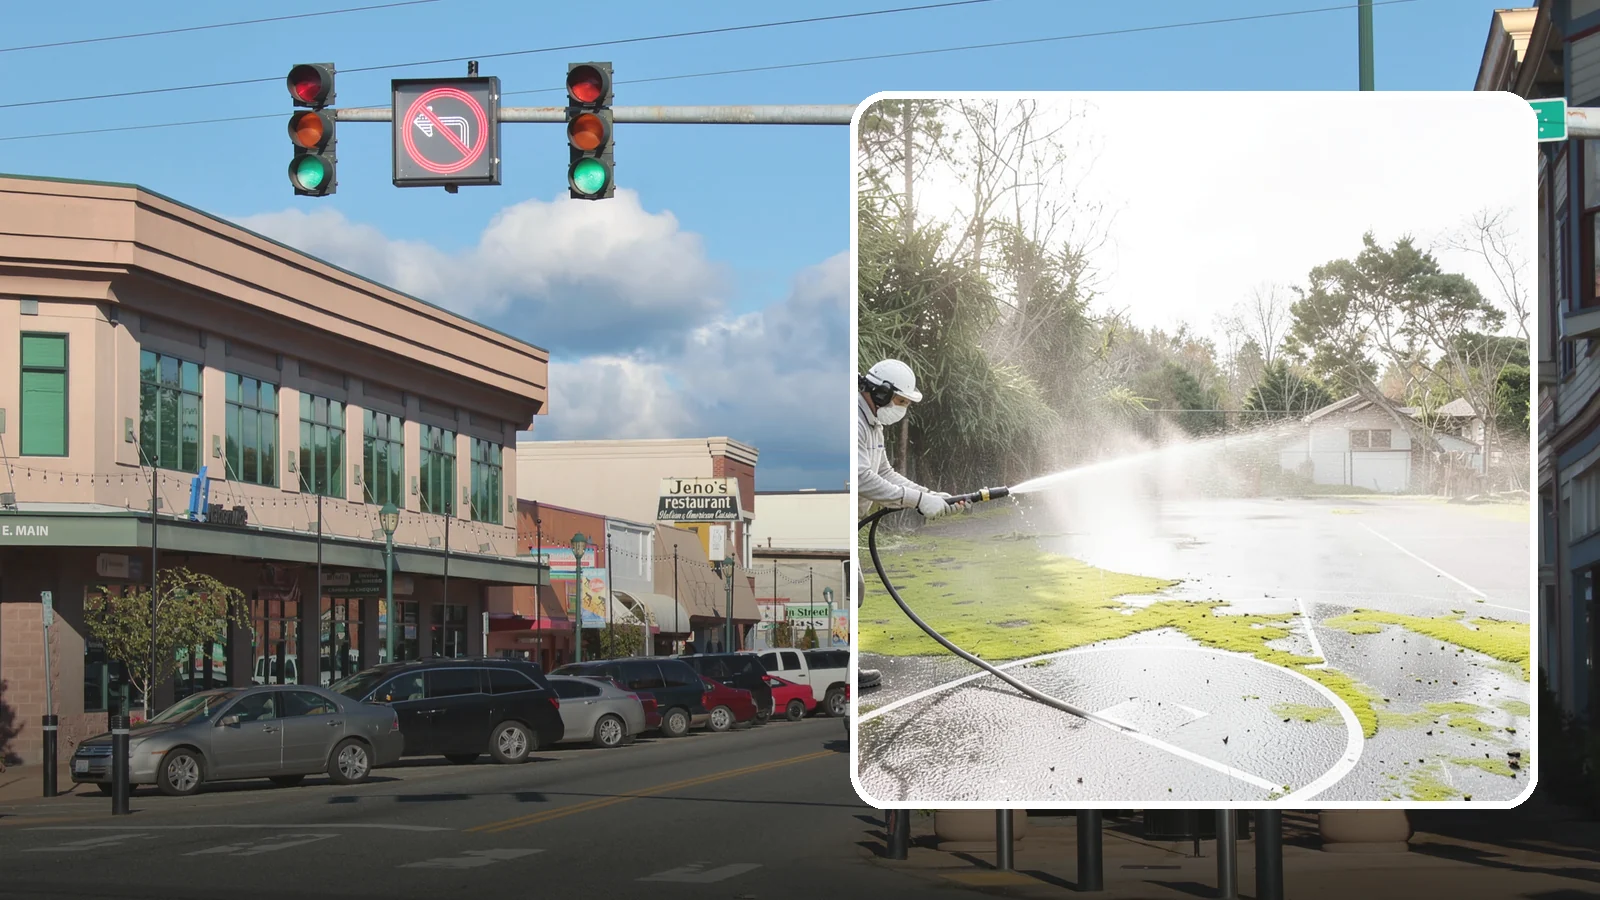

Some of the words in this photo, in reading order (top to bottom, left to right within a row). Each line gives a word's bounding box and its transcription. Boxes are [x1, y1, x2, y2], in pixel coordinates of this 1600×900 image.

[670, 480, 727, 494] Jeno's
[665, 496, 731, 509] restaurant
[658, 510, 681, 519] Italian
[686, 510, 714, 519] American
[715, 510, 737, 519] Cuisine
[2, 525, 12, 536] E.
[15, 525, 49, 536] MAIN
[797, 608, 828, 616] Street
